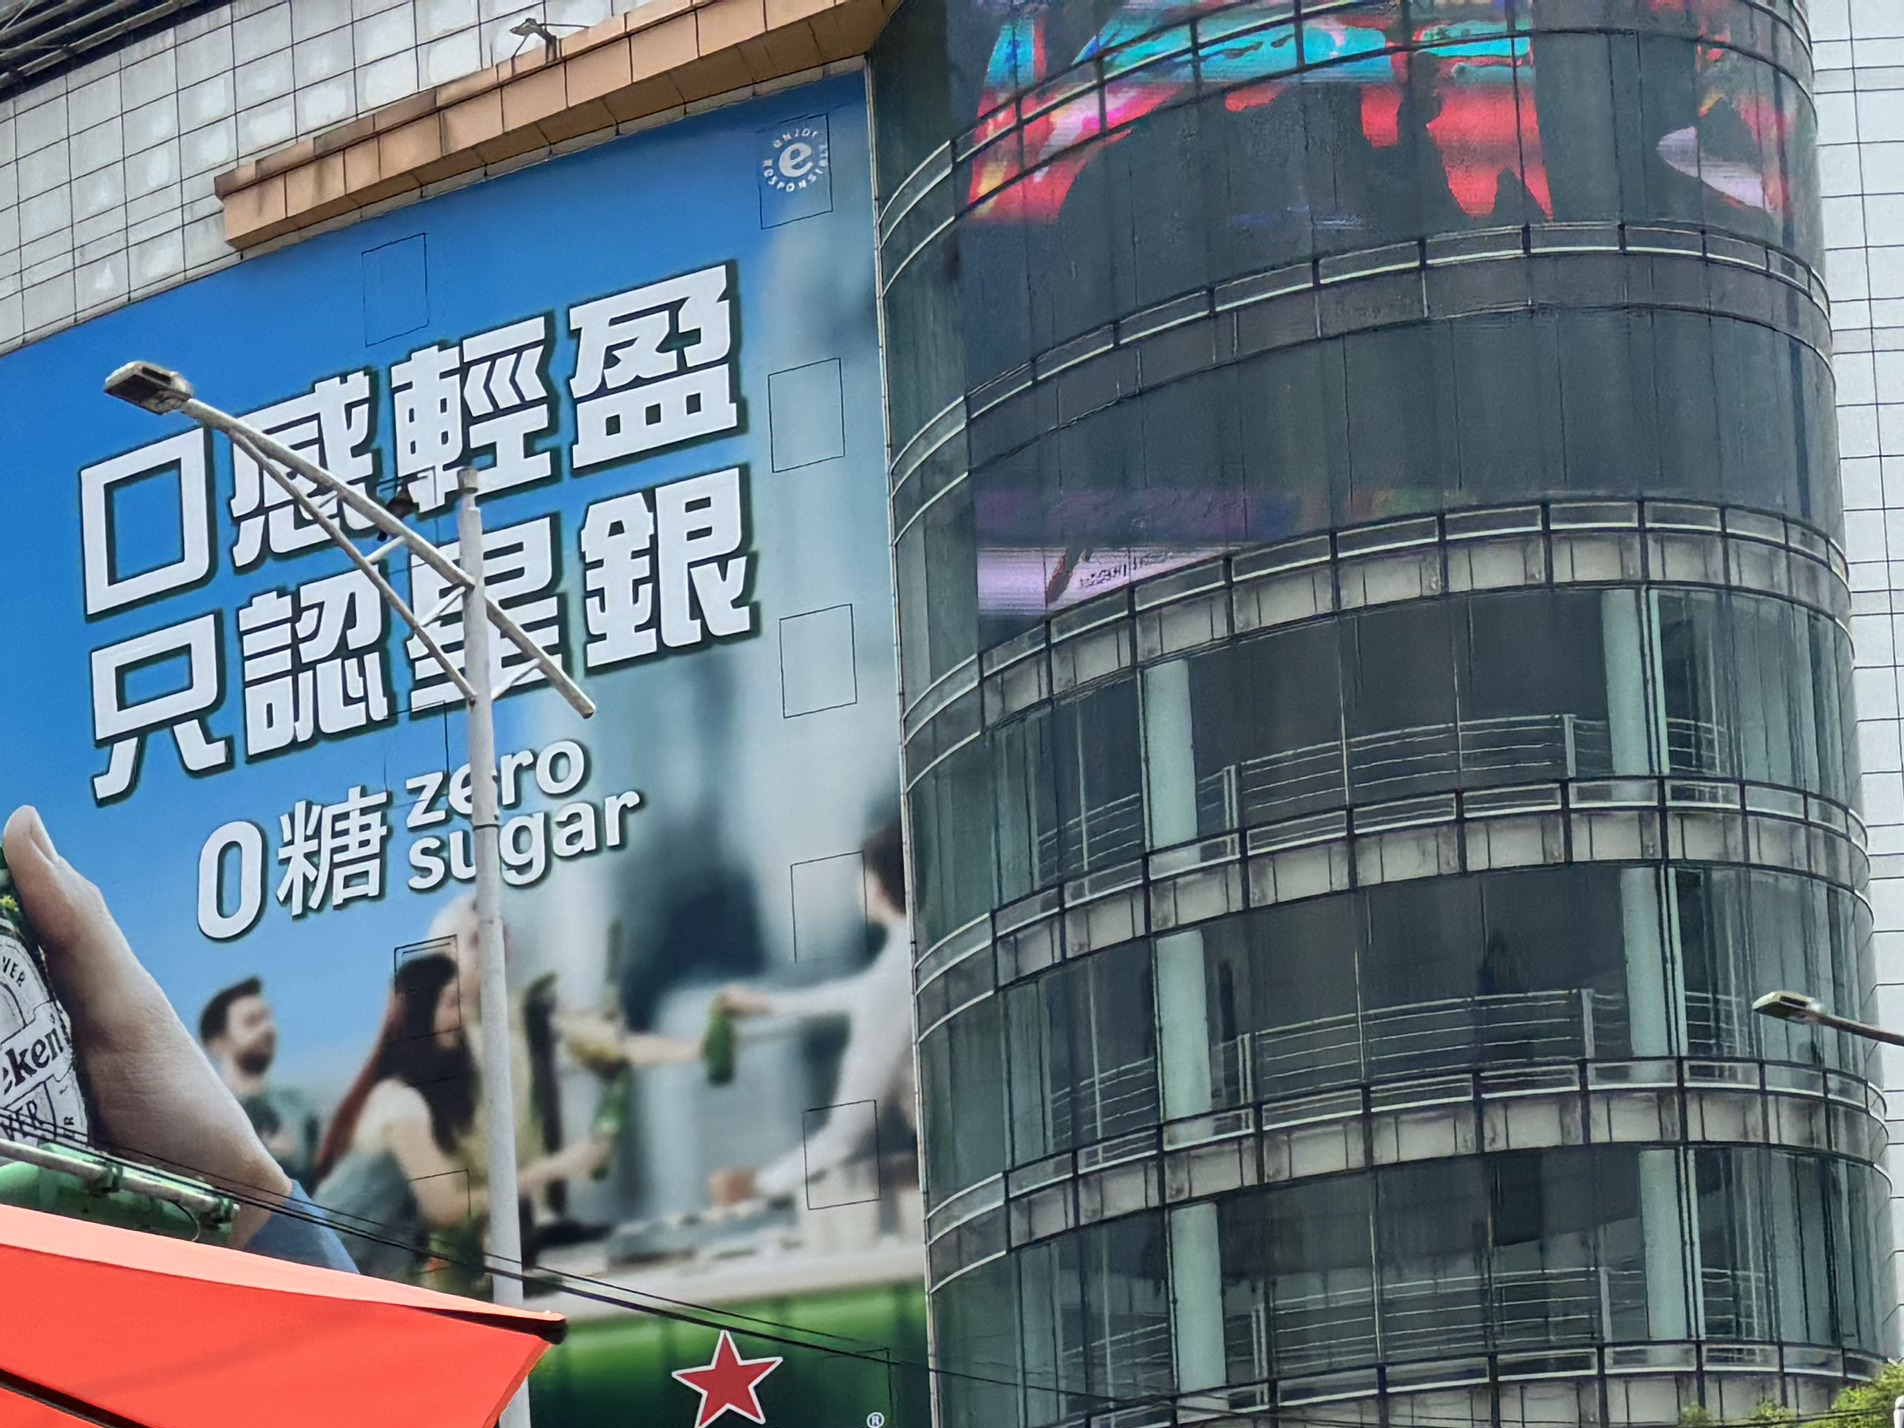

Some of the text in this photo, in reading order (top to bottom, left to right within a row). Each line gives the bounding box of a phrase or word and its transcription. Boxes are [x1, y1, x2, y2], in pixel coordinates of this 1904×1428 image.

[80, 264, 740, 616] 口感輕盈
[90, 466, 754, 799] 只認星銀
[197, 784, 389, 939] 0糖
[404, 740, 586, 829] zero
[407, 789, 641, 890] sugar
